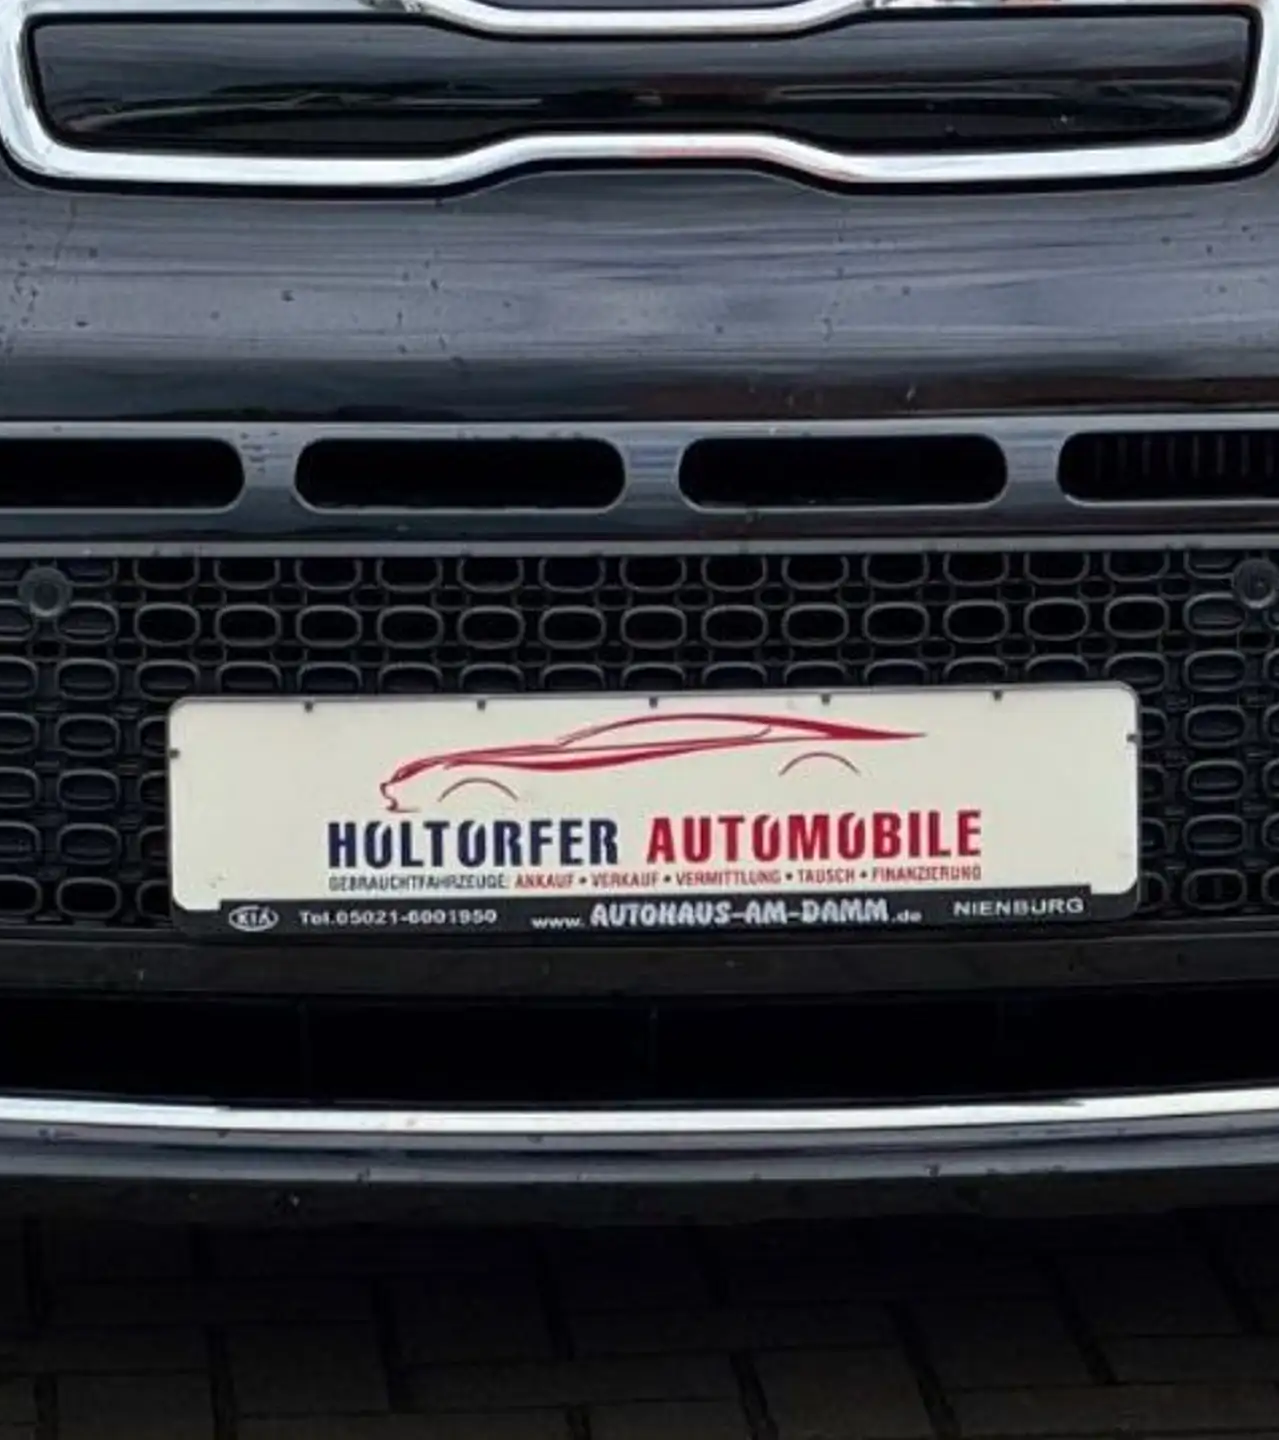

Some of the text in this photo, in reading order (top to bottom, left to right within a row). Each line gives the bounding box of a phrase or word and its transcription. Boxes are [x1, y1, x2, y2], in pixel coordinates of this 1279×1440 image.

[328, 809, 982, 869] HOLTORFER AUTOMOBILE
[514, 871, 575, 889] ANKAUF
[591, 870, 660, 888] VERKAUF
[675, 868, 782, 886] VERMITTLUNG
[797, 867, 856, 884] TAUSCH
[871, 863, 982, 882] FINANZIERUNG
[952, 897, 1086, 918] NIENBURG
